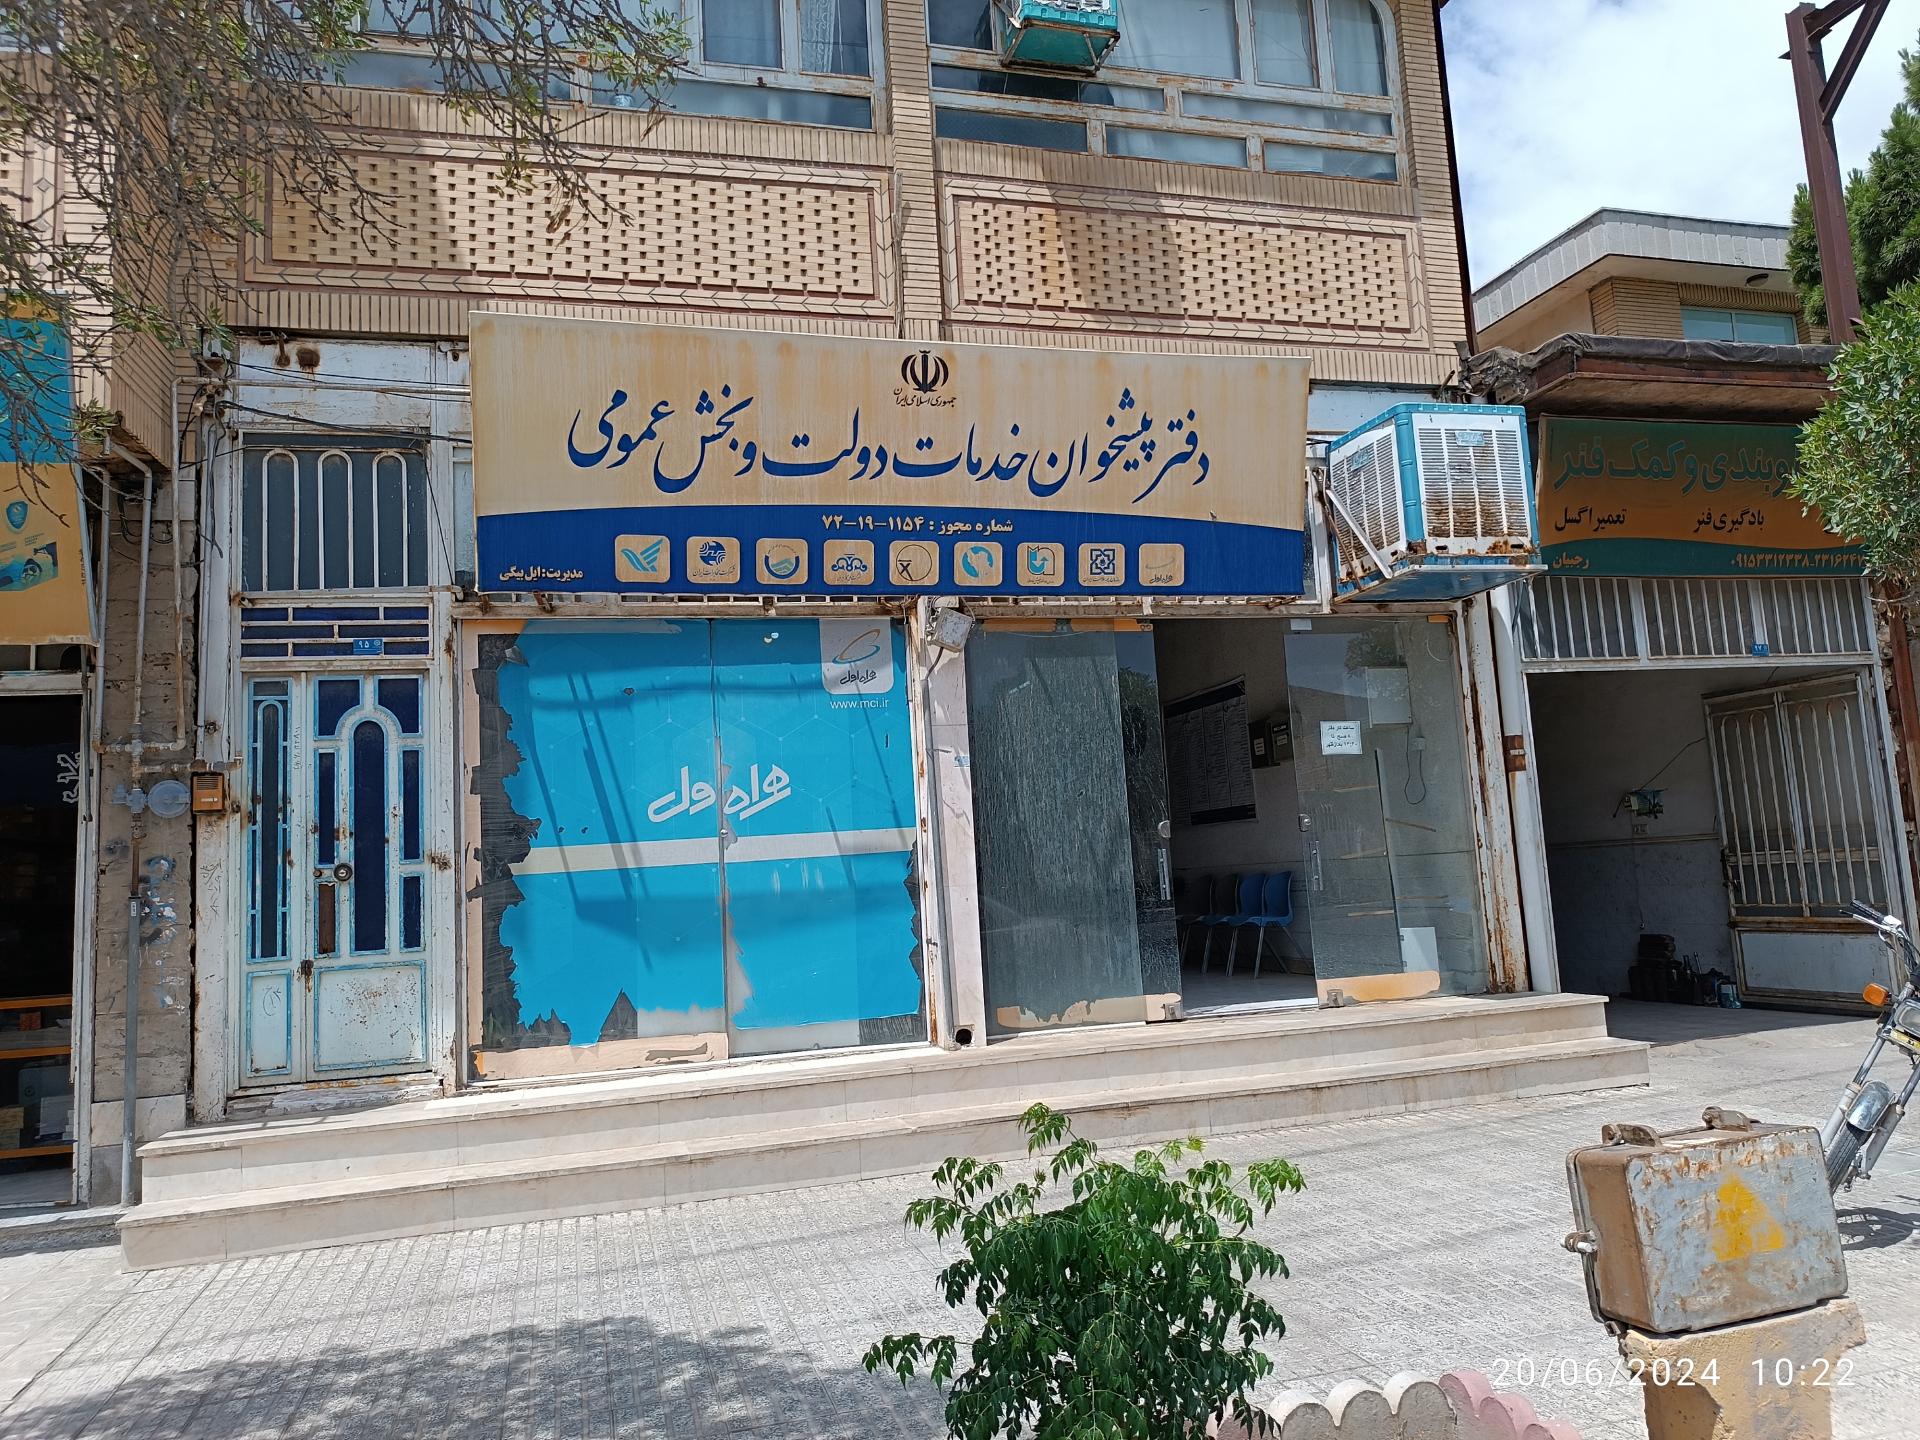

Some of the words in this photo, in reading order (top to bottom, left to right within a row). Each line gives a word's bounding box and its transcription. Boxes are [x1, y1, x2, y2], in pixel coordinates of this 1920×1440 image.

[893, 387, 907, 407] ایران
[905, 394, 930, 407] اسلامی
[930, 395, 958, 408] جمهوری
[567, 389, 674, 470] عمومی
[653, 383, 754, 494] بخش
[762, 406, 888, 481] دولت
[1027, 387, 1156, 498] پیشخوان
[734, 440, 757, 477] و
[892, 422, 1028, 482] خدمات
[1132, 408, 1210, 504] دفتر
[1553, 435, 1606, 491] فنر
[1607, 439, 1686, 481] کمک
[1680, 454, 1699, 494] و
[937, 520, 972, 536] مجوز
[974, 518, 1014, 536] شماره
[1593, 508, 1628, 533] تعمیر
[1692, 507, 1712, 533] فنر
[358, 640, 370, 648] ۹۵
[830, 697, 889, 709] www.mci.ir
